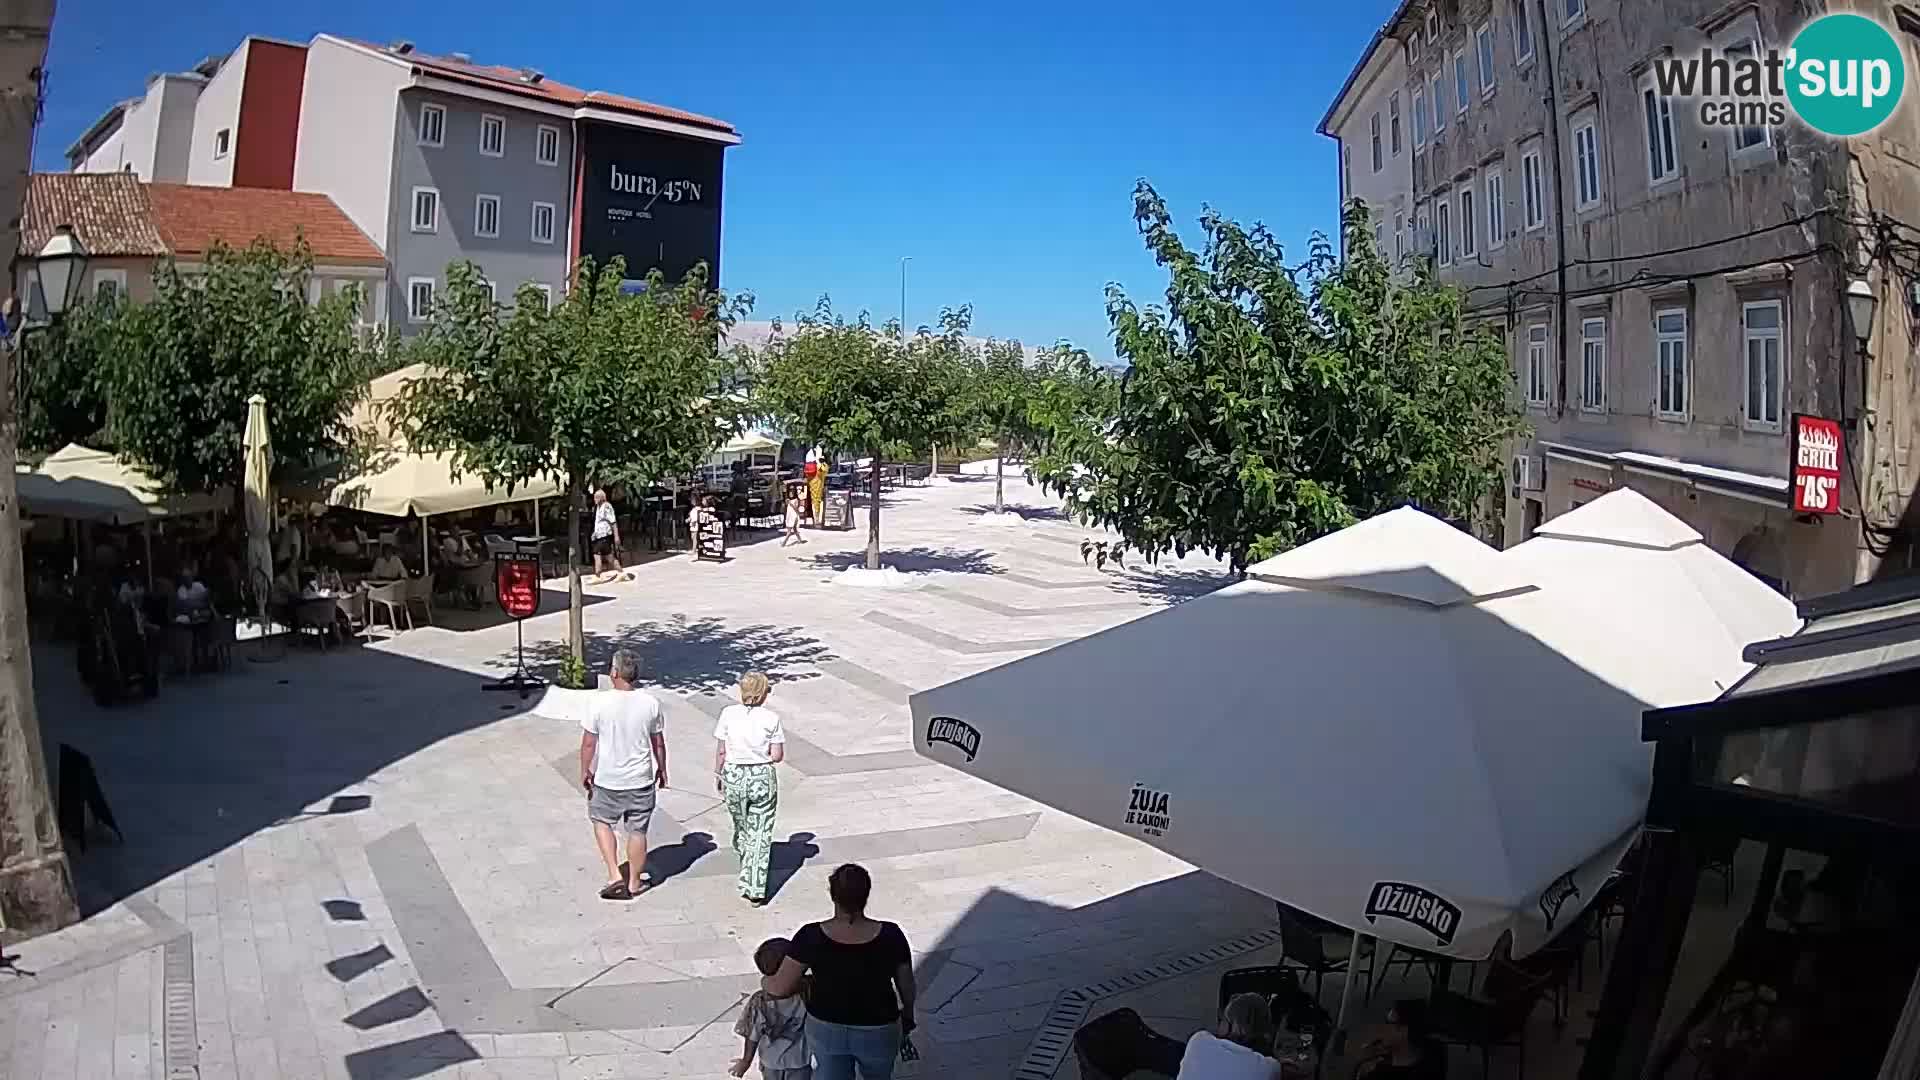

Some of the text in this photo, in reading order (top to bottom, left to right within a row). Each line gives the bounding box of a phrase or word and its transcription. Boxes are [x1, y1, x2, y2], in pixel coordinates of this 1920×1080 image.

[610, 164, 657, 195] bura
[1797, 447, 1839, 471] GRILL
[931, 719, 976, 751] Ožujsko
[1129, 782, 1169, 816] ŽUJA
[1125, 811, 1136, 824] JE
[1374, 885, 1453, 934] Ožujsko
